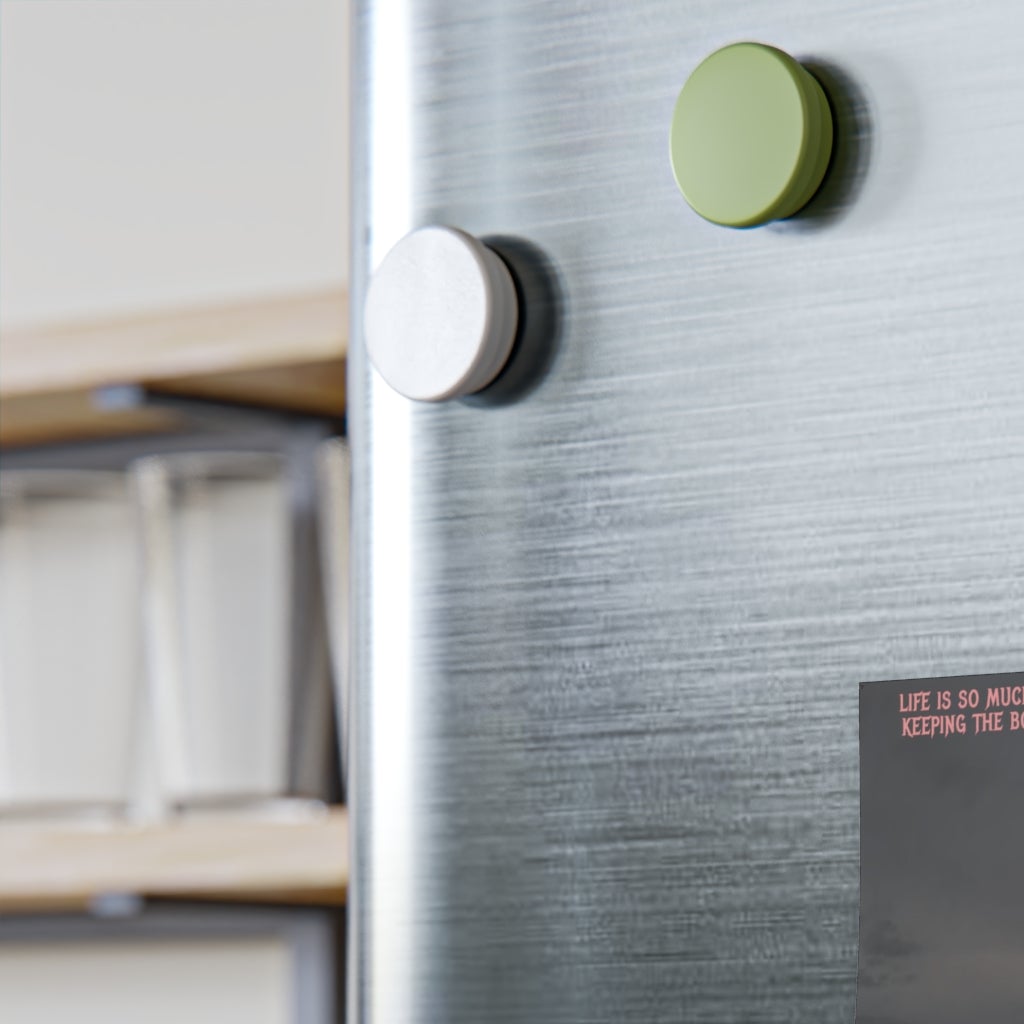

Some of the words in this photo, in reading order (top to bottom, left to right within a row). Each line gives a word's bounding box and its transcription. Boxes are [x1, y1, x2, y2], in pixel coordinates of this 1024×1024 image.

[899, 690, 931, 713] LIFE
[936, 690, 952, 711] IS
[957, 688, 980, 710] SO
[901, 713, 967, 738] KEEPING
[972, 711, 1004, 734] THE
